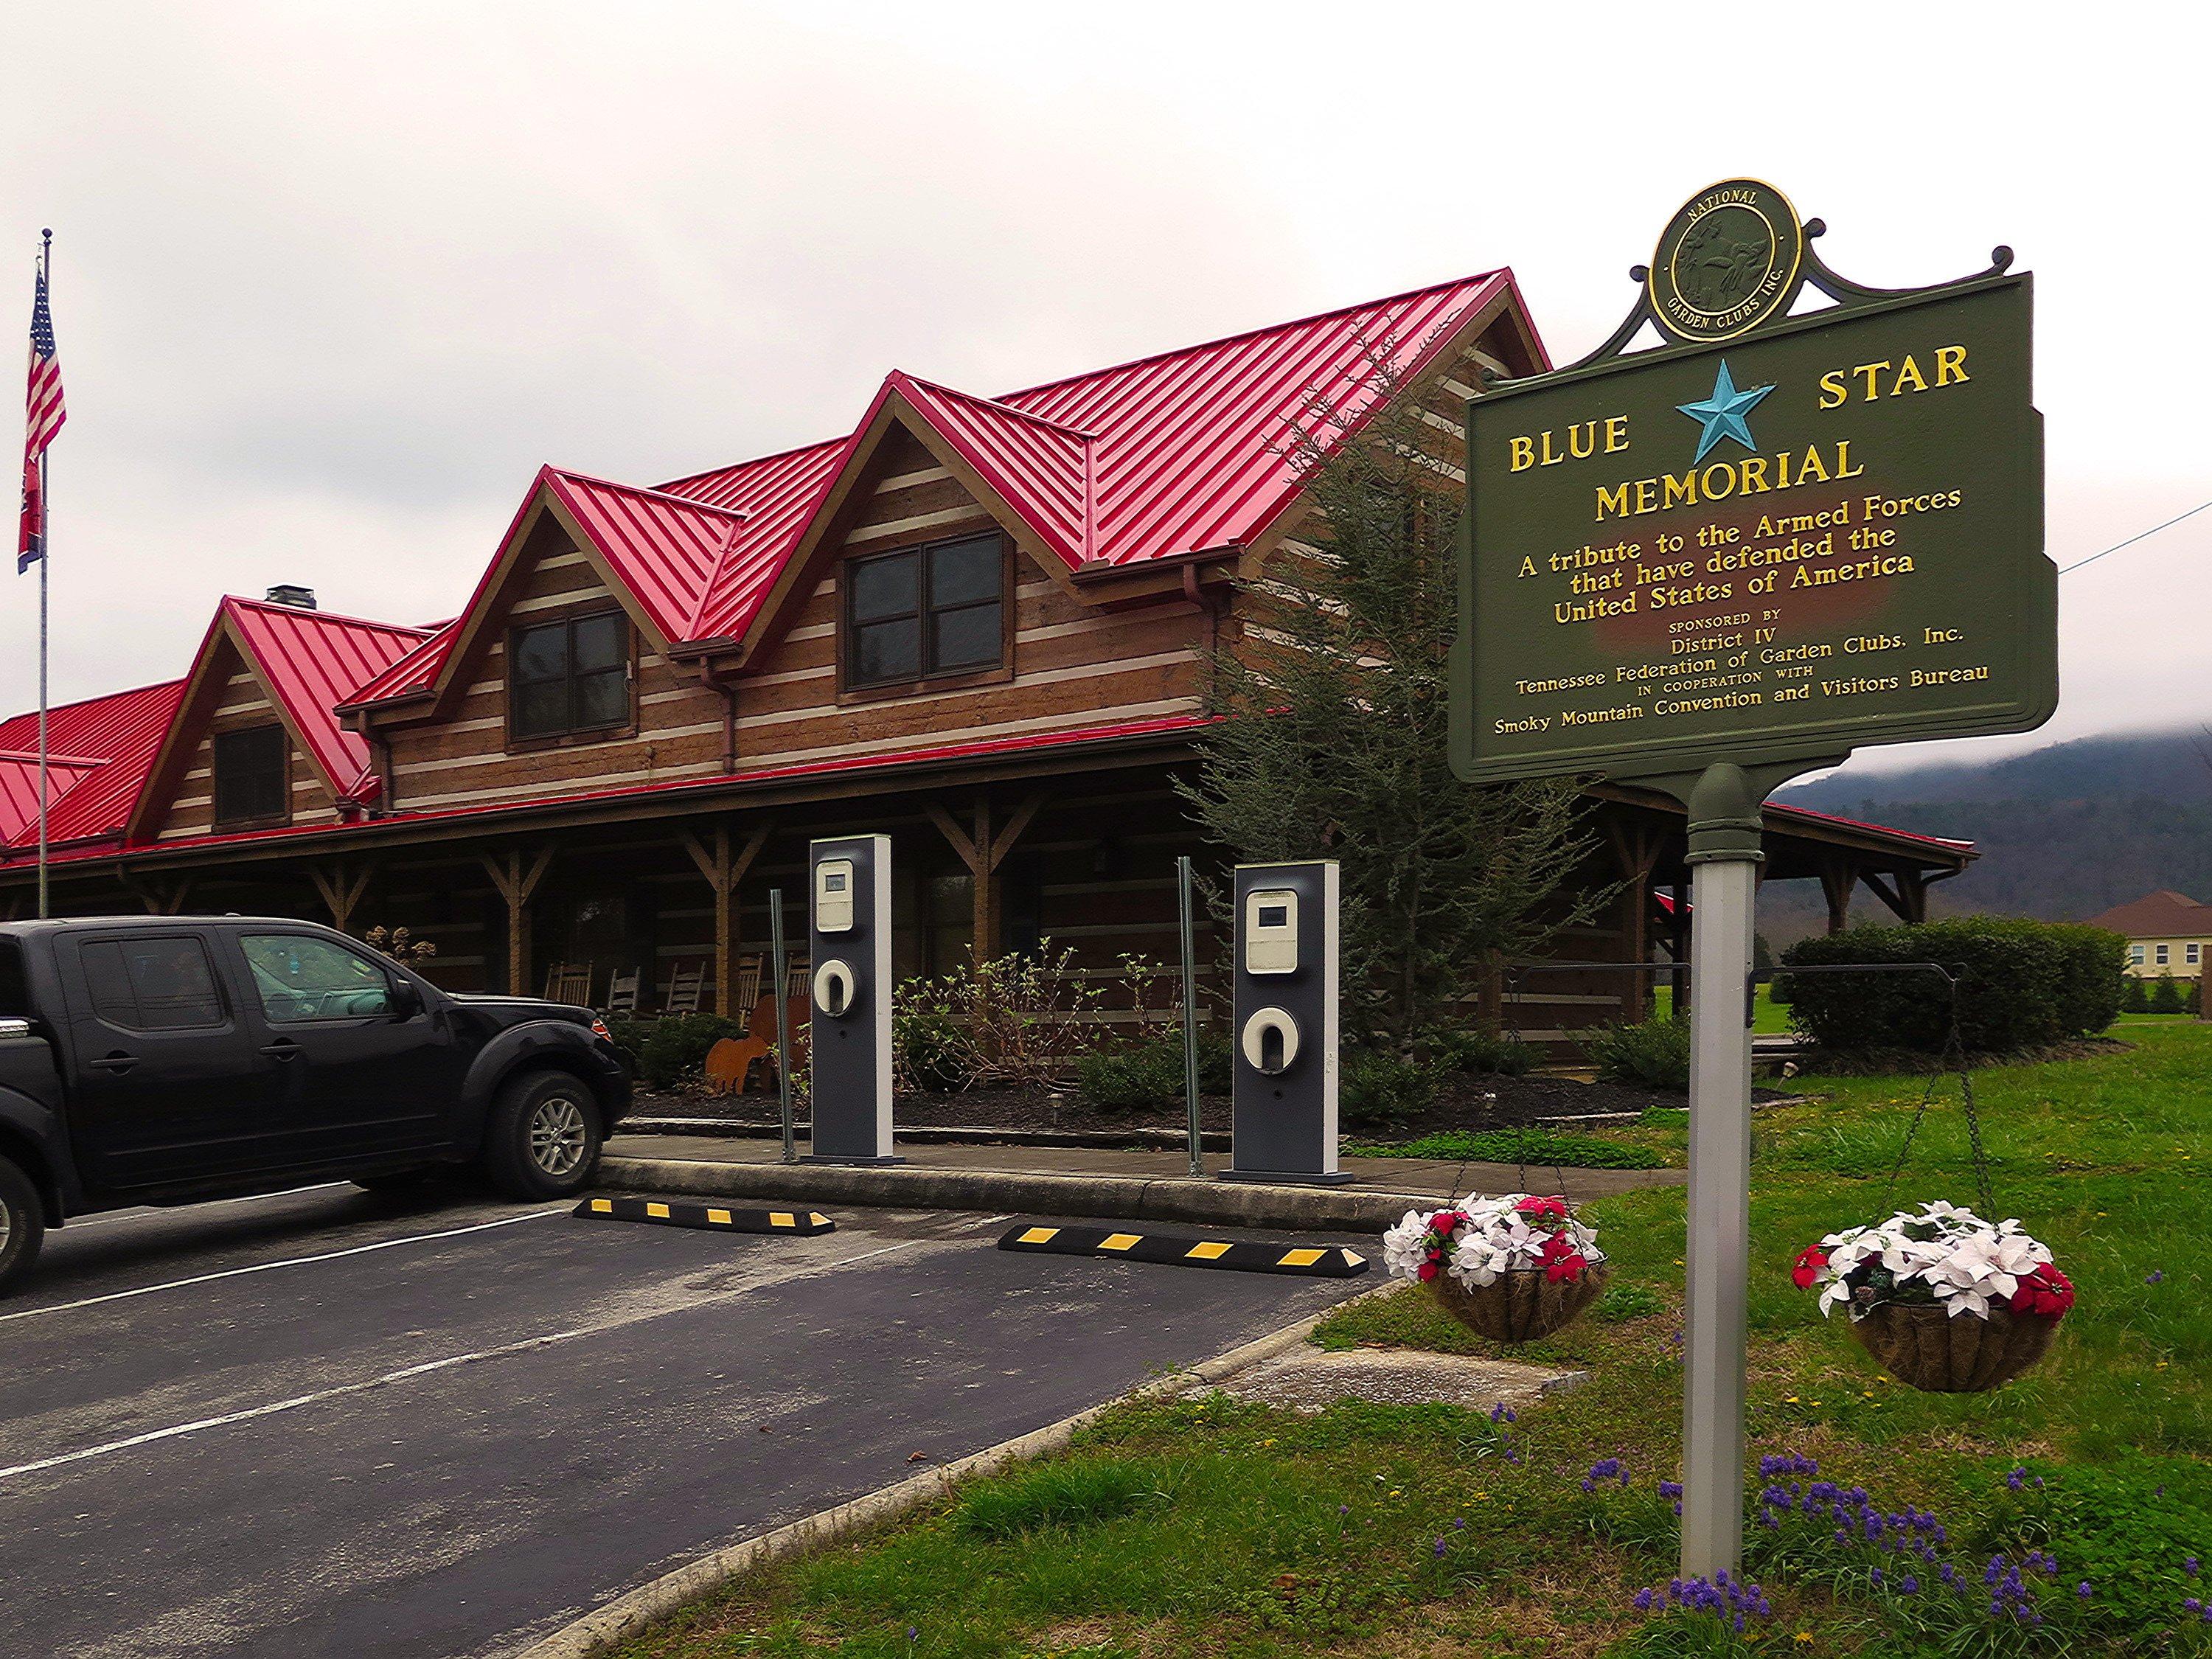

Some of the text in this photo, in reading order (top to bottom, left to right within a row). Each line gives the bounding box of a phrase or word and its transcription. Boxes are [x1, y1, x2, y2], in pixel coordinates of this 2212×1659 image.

[1688, 189, 1757, 222] NATIONAL
[1667, 269, 1784, 329] GARDEN CLUBS INC.
[1509, 345, 1971, 473] BLUE STAR
[1595, 440, 1865, 522] MEMORIAL
[1517, 489, 1961, 578] A tribute to the Armed Forces
[1569, 526, 1896, 594] that have defended the
[1554, 554, 1915, 624] United States of America
[1668, 608, 1781, 634] SPONSORED BY
[1514, 673, 1606, 695] Tennessee
[1615, 658, 1717, 682] Federation
[1728, 650, 1749, 668] of
[1759, 644, 1832, 664] Garden
[1924, 627, 1964, 644] Inc.
[1671, 627, 1777, 655] District IV
[1495, 667, 1989, 734] Smoky Mountain Convention and Visitors Bureau
[1638, 665, 1814, 697] IN COOPERATION WITH
